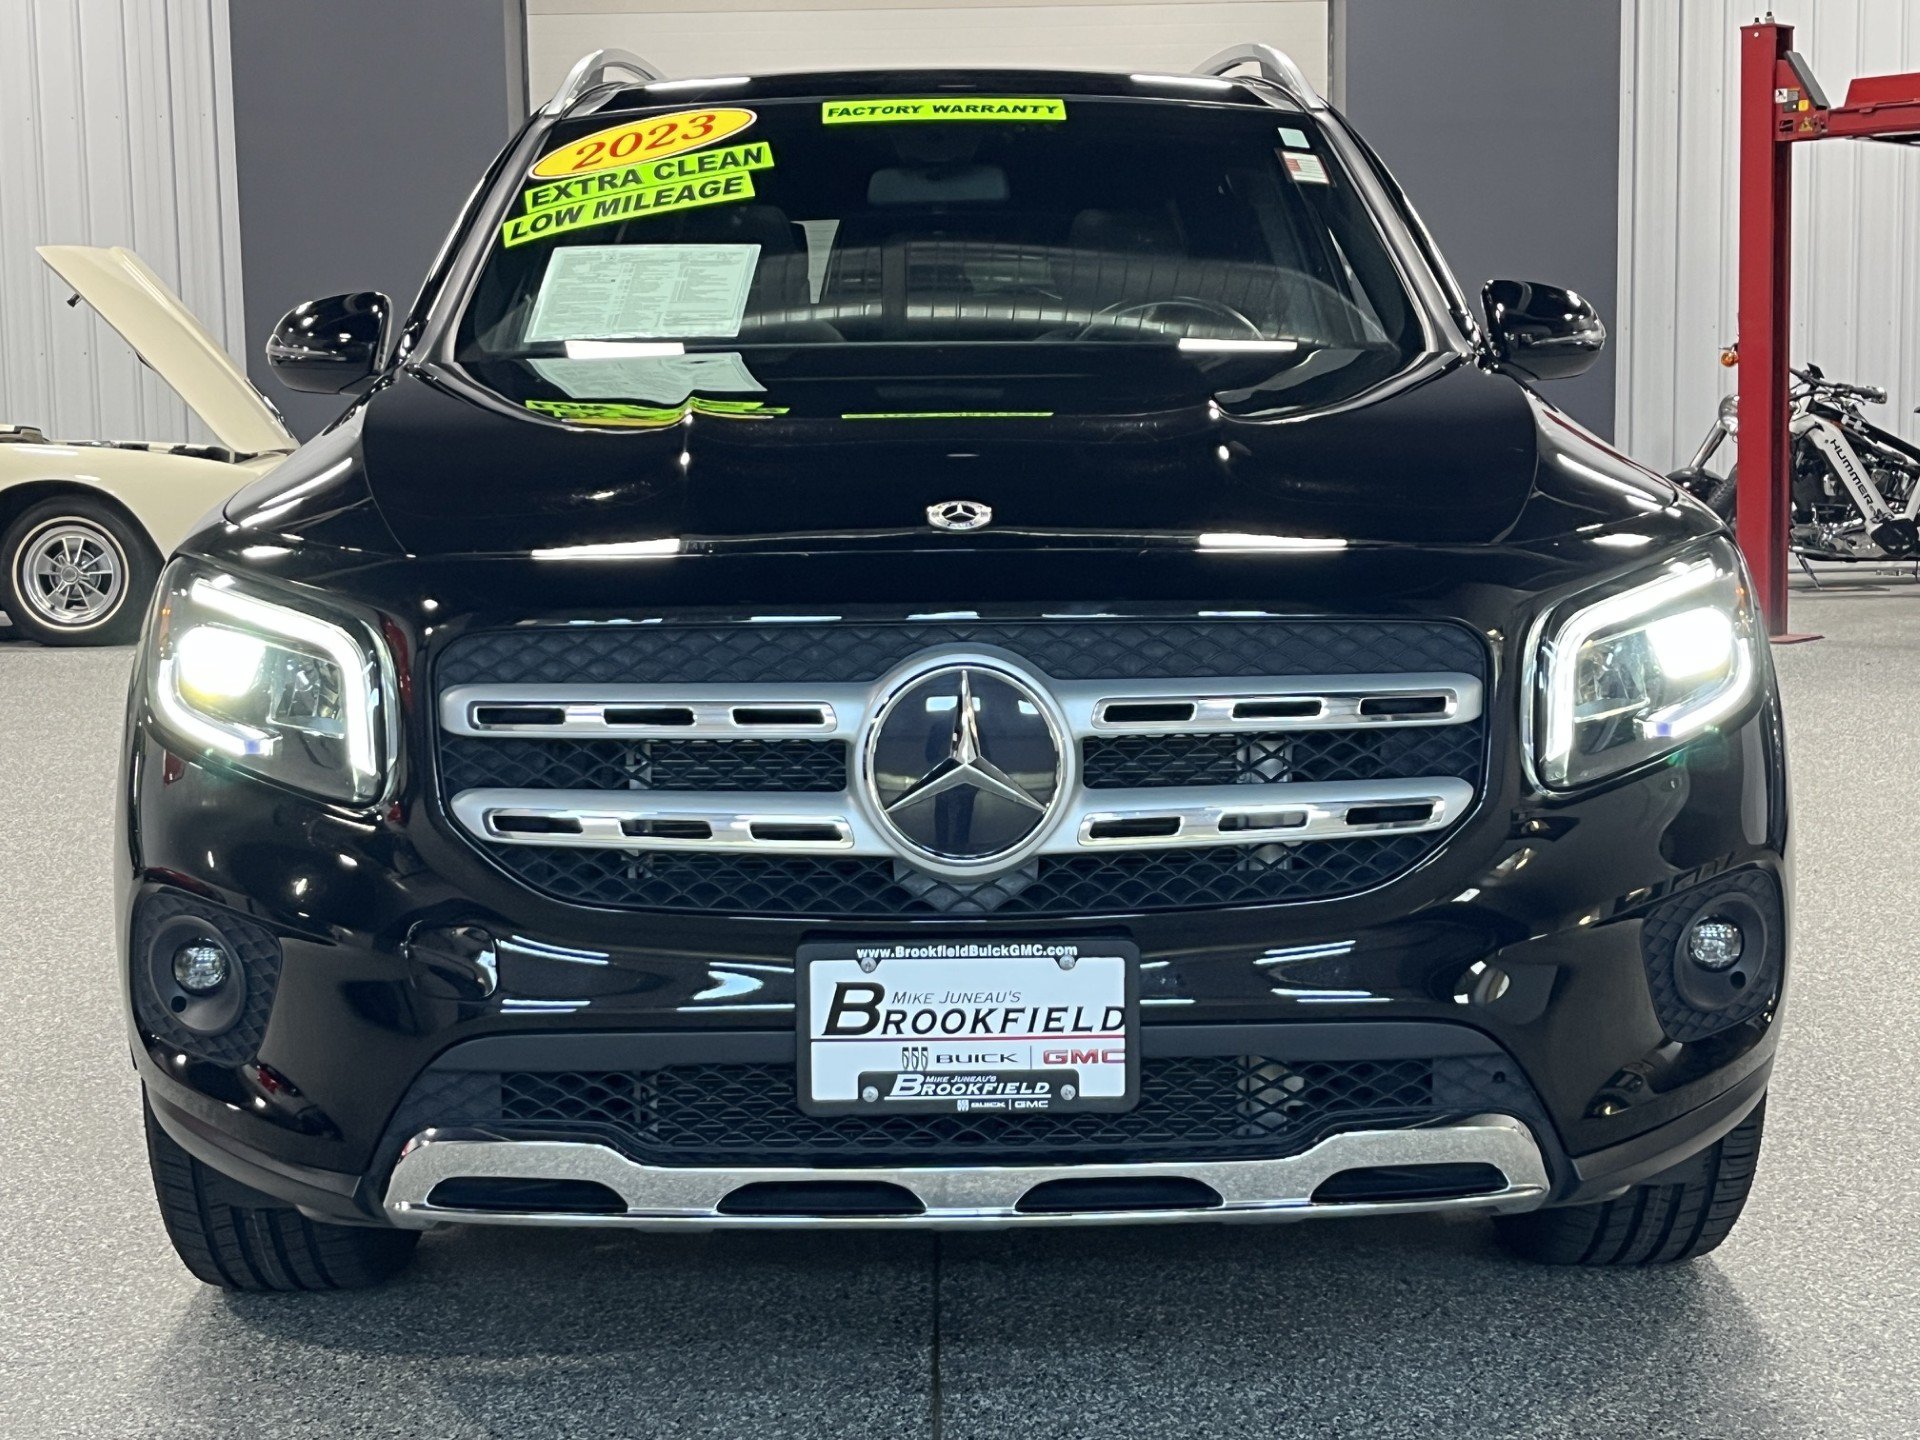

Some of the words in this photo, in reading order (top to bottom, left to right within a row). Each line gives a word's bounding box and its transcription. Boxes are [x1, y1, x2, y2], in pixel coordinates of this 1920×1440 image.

[827, 105, 924, 117] FACTORY
[932, 104, 1059, 114] WARRANTY
[571, 114, 717, 171] 2023
[531, 168, 643, 208] EXTRA
[653, 147, 764, 181] CLEAN
[509, 204, 586, 242] LOW
[592, 175, 745, 219] MILEAGE
[1830, 439, 1874, 504] HUMMER
[856, 944, 1078, 959] www.BrookfieldBuickGMC.com
[892, 991, 935, 1004] MIKE
[939, 991, 1021, 1004] JUNEAU'S
[821, 981, 1126, 1036] BROOKFIELD
[936, 1053, 1019, 1064] BUICK
[1043, 1048, 1126, 1065] GMC
[890, 1073, 1050, 1097] BROOKFIELD
[925, 1075, 950, 1084] MIKE
[1014, 1100, 1049, 1108] GMC
